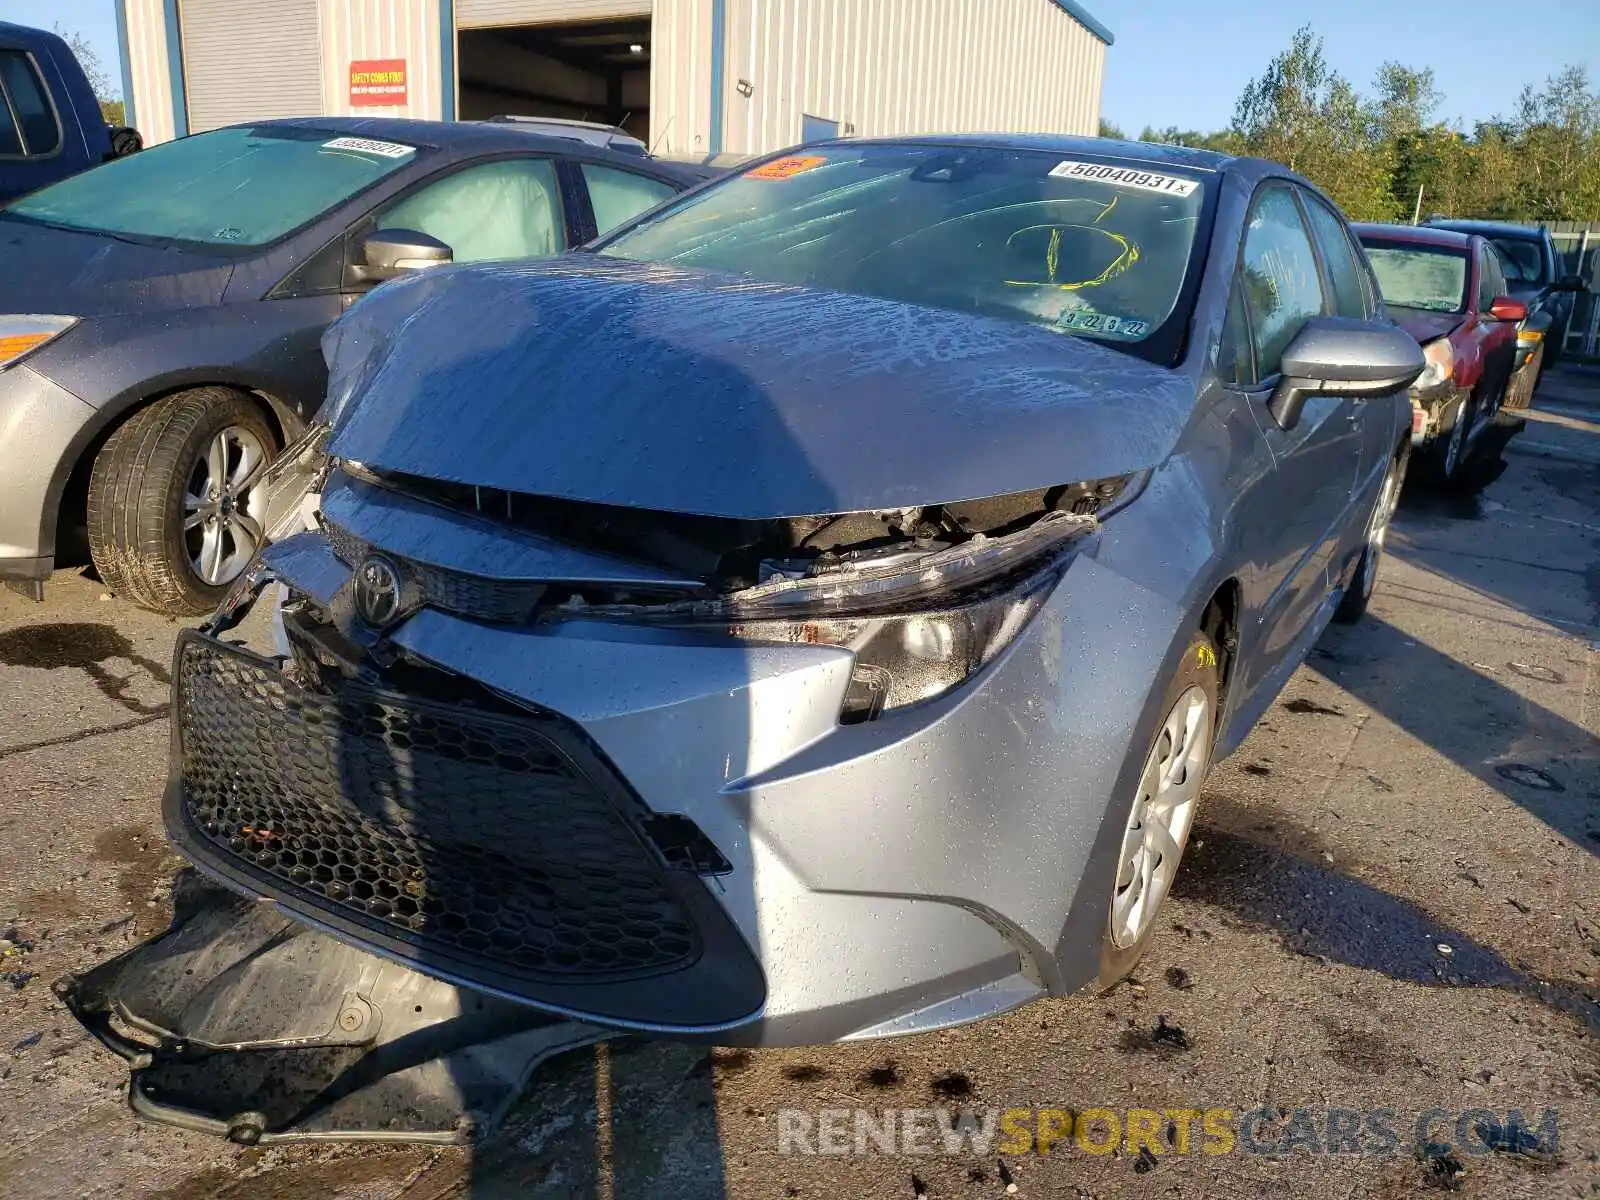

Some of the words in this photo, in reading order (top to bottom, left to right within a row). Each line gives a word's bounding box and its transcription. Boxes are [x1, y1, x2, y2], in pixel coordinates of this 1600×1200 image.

[352, 71, 369, 84] SAFETY
[370, 71, 389, 84] COMES
[1070, 163, 1177, 190] 56040931
[1084, 315, 1100, 328] 22
[1127, 321, 1146, 334] 22
